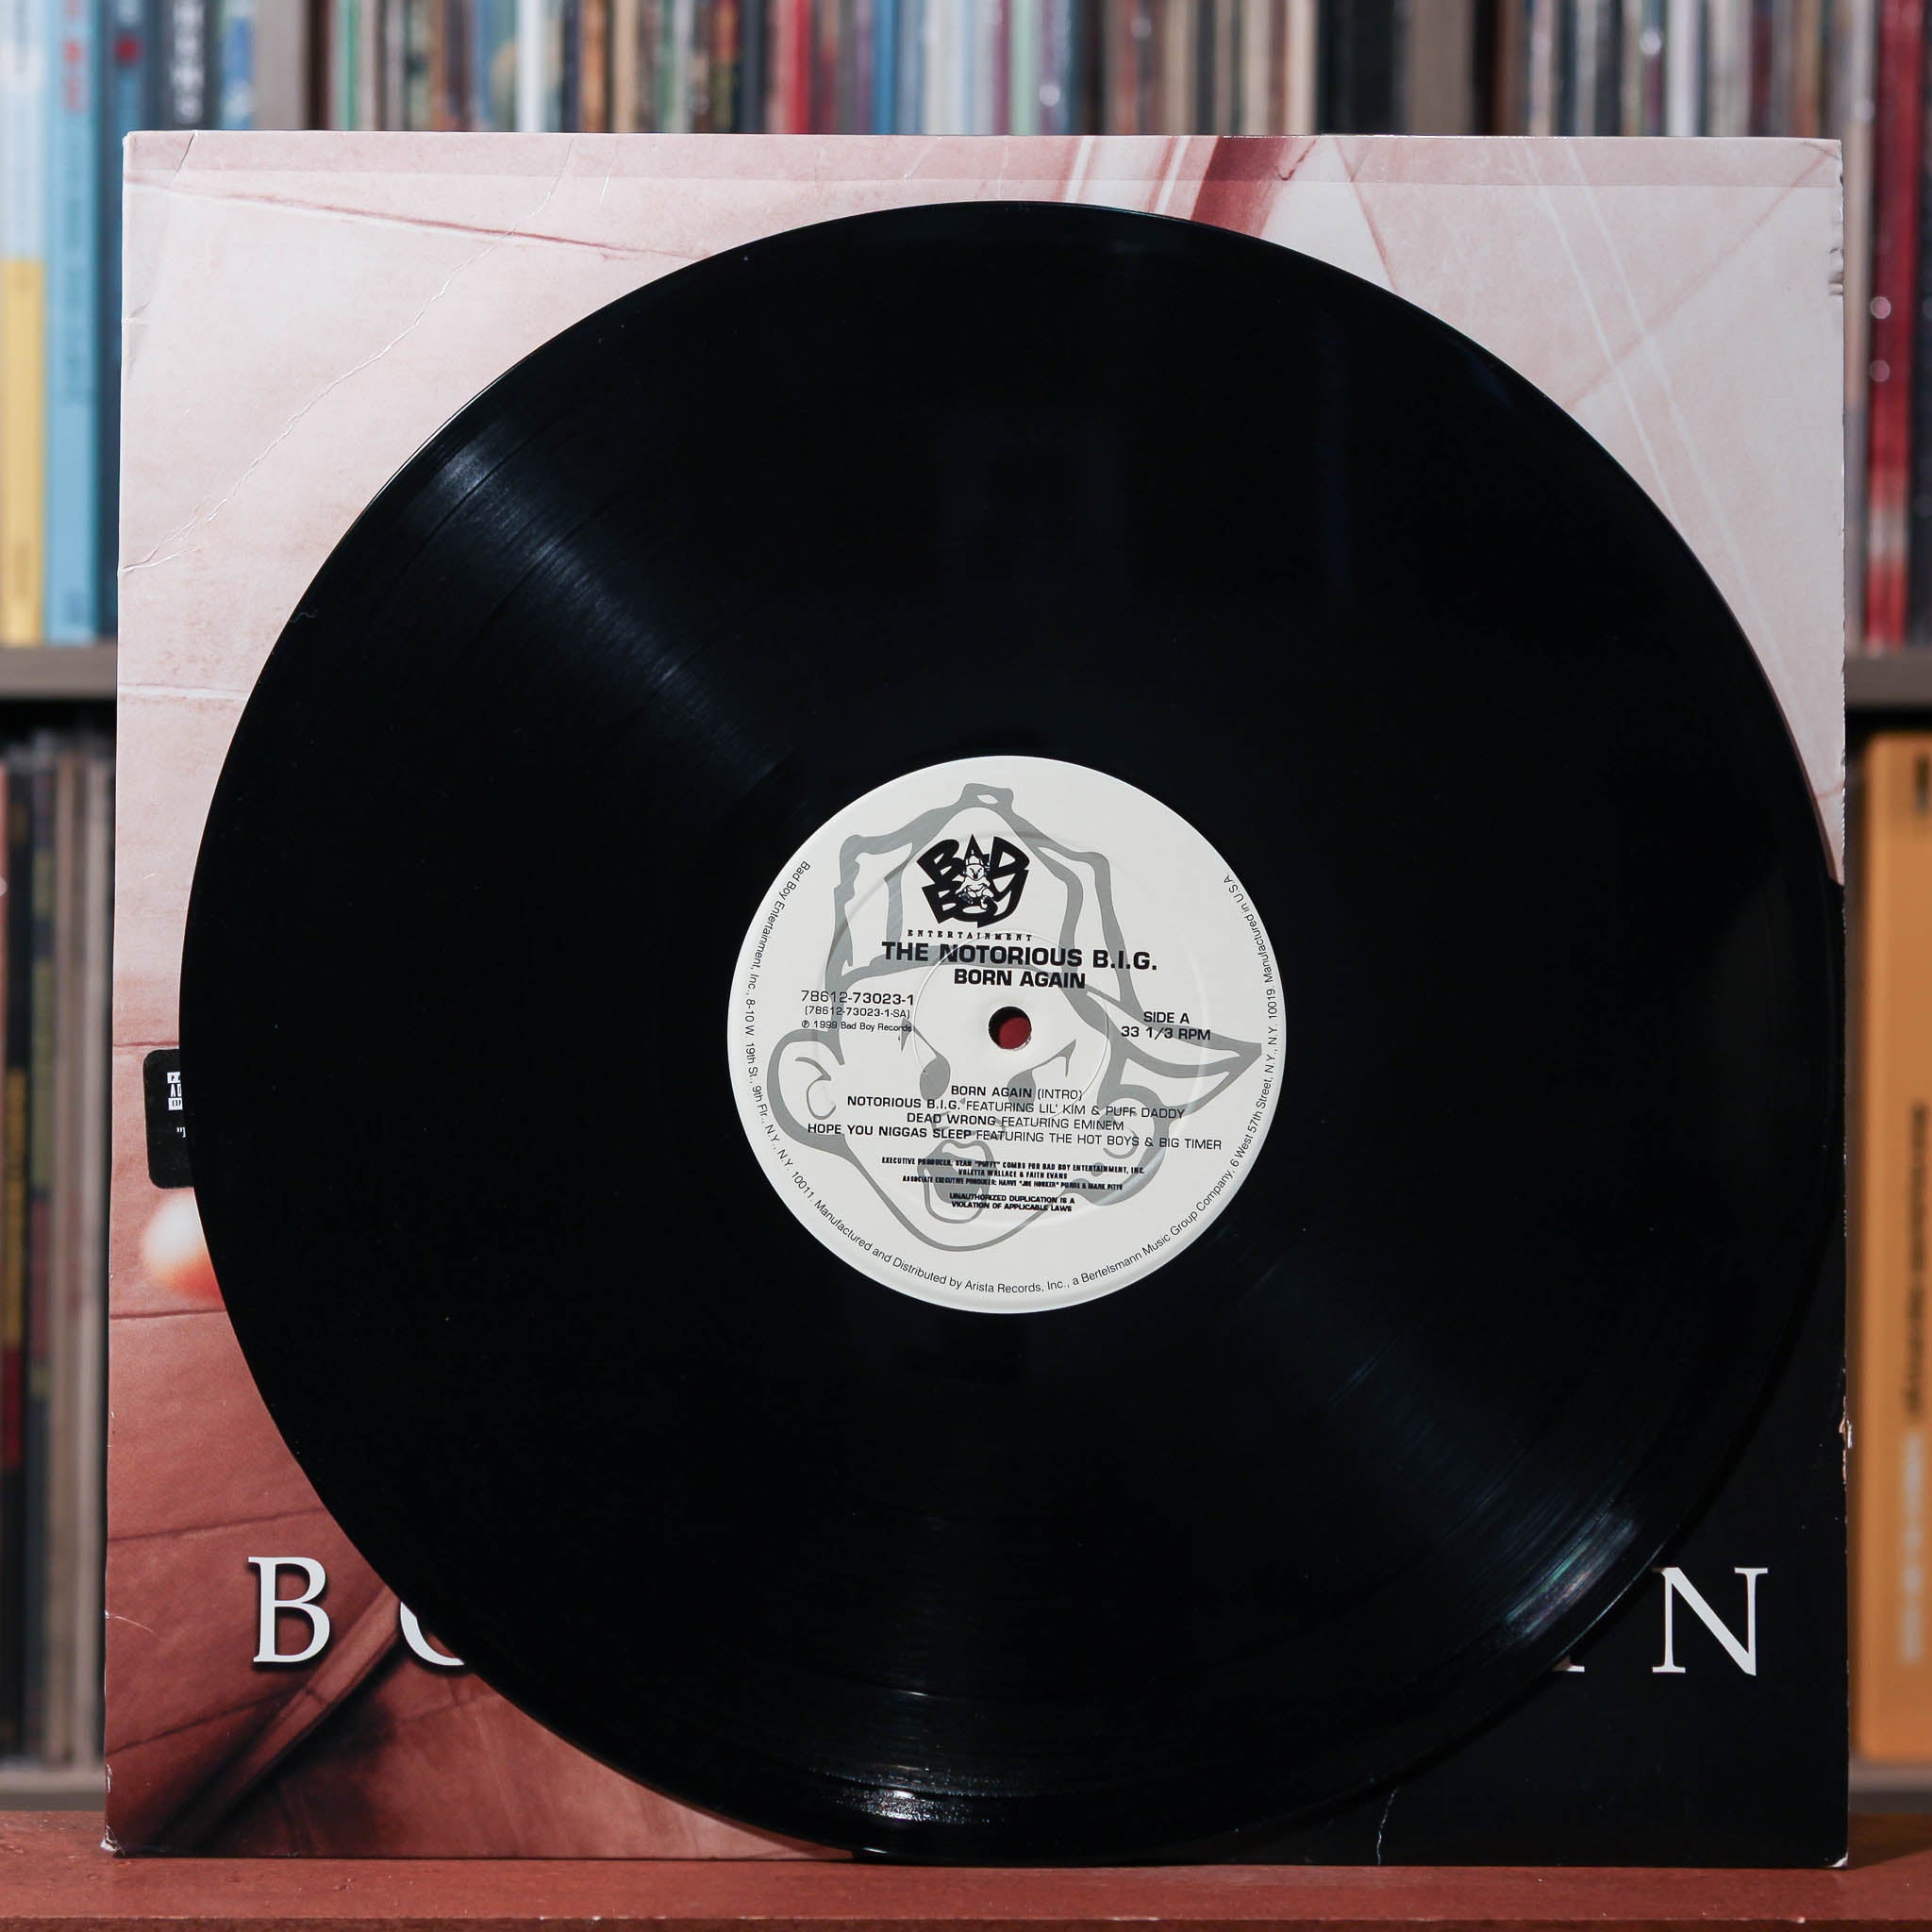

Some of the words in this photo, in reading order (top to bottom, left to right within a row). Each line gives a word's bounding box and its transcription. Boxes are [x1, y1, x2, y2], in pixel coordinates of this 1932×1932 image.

[916, 834, 1030, 884] BAD
[791, 860, 811, 882] Bad
[778, 880, 797, 901] Boy
[1241, 902, 1251, 914] in
[750, 900, 786, 970] Entertainment,
[908, 929, 1033, 941] ENTERTAINMENT
[881, 941, 929, 962] THE
[939, 943, 1083, 968] NOTORIOUS
[1092, 949, 1158, 971] B.I.G.
[1243, 913, 1274, 983] Manufactured
[954, 968, 1013, 987] BORN
[1019, 971, 1086, 990] AGAIN
[801, 990, 914, 1006] 78612-73023-1
[744, 998, 756, 1023] 8-10
[805, 1006, 910, 1020] (78612-73023-1-SA)
[1143, 1011, 1175, 1024] SIDE
[1179, 1012, 1191, 1024] A
[813, 1021, 838, 1029] 1999
[841, 1021, 858, 1030] Bad
[859, 1022, 875, 1033] Boy
[877, 1022, 912, 1032] Records
[1121, 1025, 1140, 1038] 33
[1145, 1026, 1174, 1041] 1/3
[1178, 1027, 1211, 1041] RPM
[745, 1042, 757, 1065] 19th
[752, 1085, 763, 1103] 9th
[951, 1085, 987, 1097] BORN
[991, 1087, 1033, 1099] AGAIN
[1038, 1089, 1083, 1102] (INTRO)
[1256, 1076, 1274, 1109] Street,
[847, 1095, 922, 1108] NOTORIOUS
[926, 1098, 962, 1110] B.I.G.
[966, 1100, 1035, 1113] FEATURING
[1039, 1104, 1058, 1114] LIL'
[1062, 1104, 1086, 1115] KIM
[1091, 1105, 1101, 1116] &
[1106, 1106, 1136, 1118] PUFF
[1141, 1106, 1186, 1120] DADDY
[907, 1112, 942, 1124] DEAD
[946, 1114, 997, 1126] WRONG
[1000, 1116, 1070, 1129] FEATURING
[1074, 1119, 1124, 1131] EMINEM
[1247, 1110, 1263, 1134] 57th
[808, 1123, 842, 1136] HOPE
[847, 1124, 874, 1136] YOU
[878, 1125, 927, 1139] NIGGAS
[932, 1126, 973, 1140] SLEEP
[976, 1129, 1044, 1142] FEATURING
[1049, 1132, 1073, 1144] THE
[1077, 1134, 1103, 1145] HOT
[1107, 1135, 1140, 1147] BOYS
[1144, 1137, 1155, 1148] &
[1158, 1137, 1180, 1148] BIG
[1184, 1138, 1223, 1151] TIMER
[1234, 1134, 1254, 1158] West
[882, 1157, 916, 1165] EXECUTIVE
[1002, 1161, 1026, 1170] COMBS
[1229, 1158, 1241, 1168] 6
[902, 1175, 934, 1184] ASSOCIATE
[935, 1176, 965, 1185] EXECUTIVE
[949, 1191, 1008, 1202] UNAUTHORIZED
[1008, 1195, 1058, 1204] DUPLICATION
[1195, 1170, 1236, 1212] Company,
[951, 1200, 991, 1209] VIOLATION
[1004, 1203, 1049, 1212] APPLICABLE
[814, 1199, 874, 1252] Manufactured
[1170, 1210, 1199, 1236] Group
[872, 1248, 893, 1263] and
[1141, 1234, 1172, 1257] Music
[892, 1257, 948, 1285] Distributed
[1080, 1252, 1143, 1283] Bertelsmann
[949, 1276, 963, 1291] by
[964, 1280, 995, 1293] Arista
[997, 1282, 1044, 1294] Records,
[1072, 1277, 1080, 1286] a
